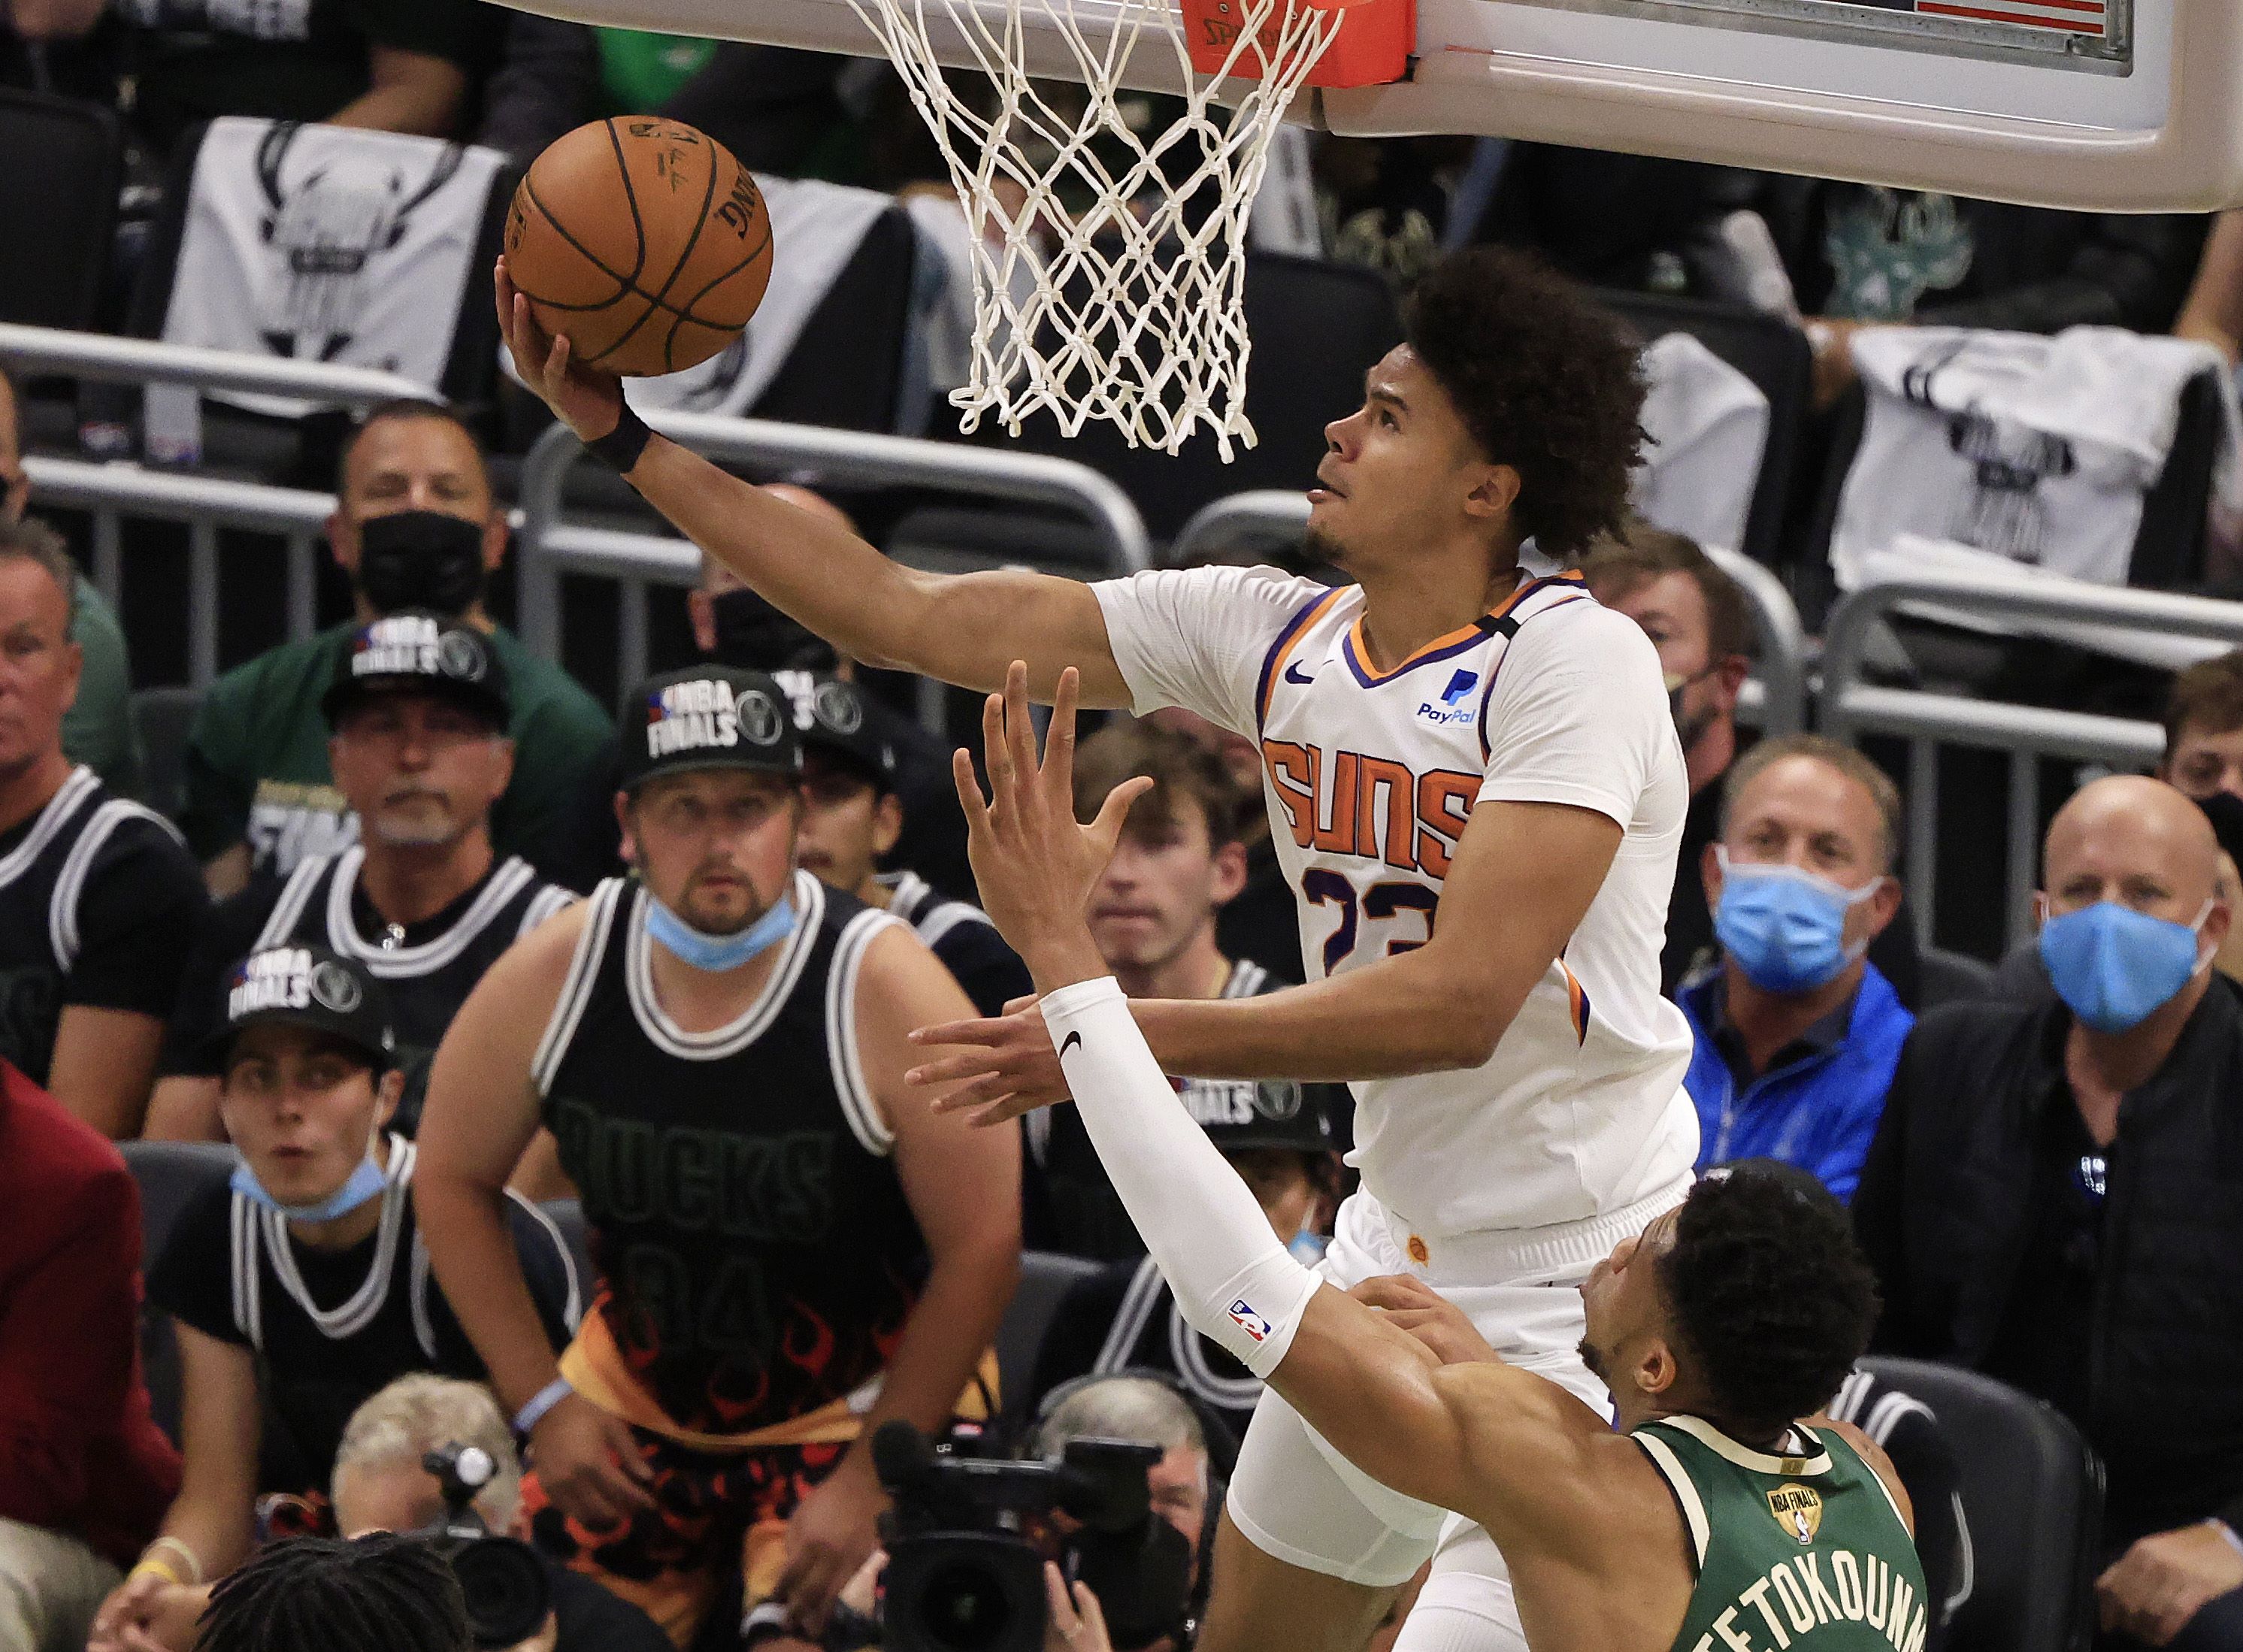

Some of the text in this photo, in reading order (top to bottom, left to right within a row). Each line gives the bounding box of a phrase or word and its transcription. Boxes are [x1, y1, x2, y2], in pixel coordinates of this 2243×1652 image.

[1416, 702, 1476, 725] PayPal
[647, 713, 738, 758] FINALS
[1262, 737, 1485, 880] SUNS
[1770, 1490, 1818, 1513] NBA FINALS
